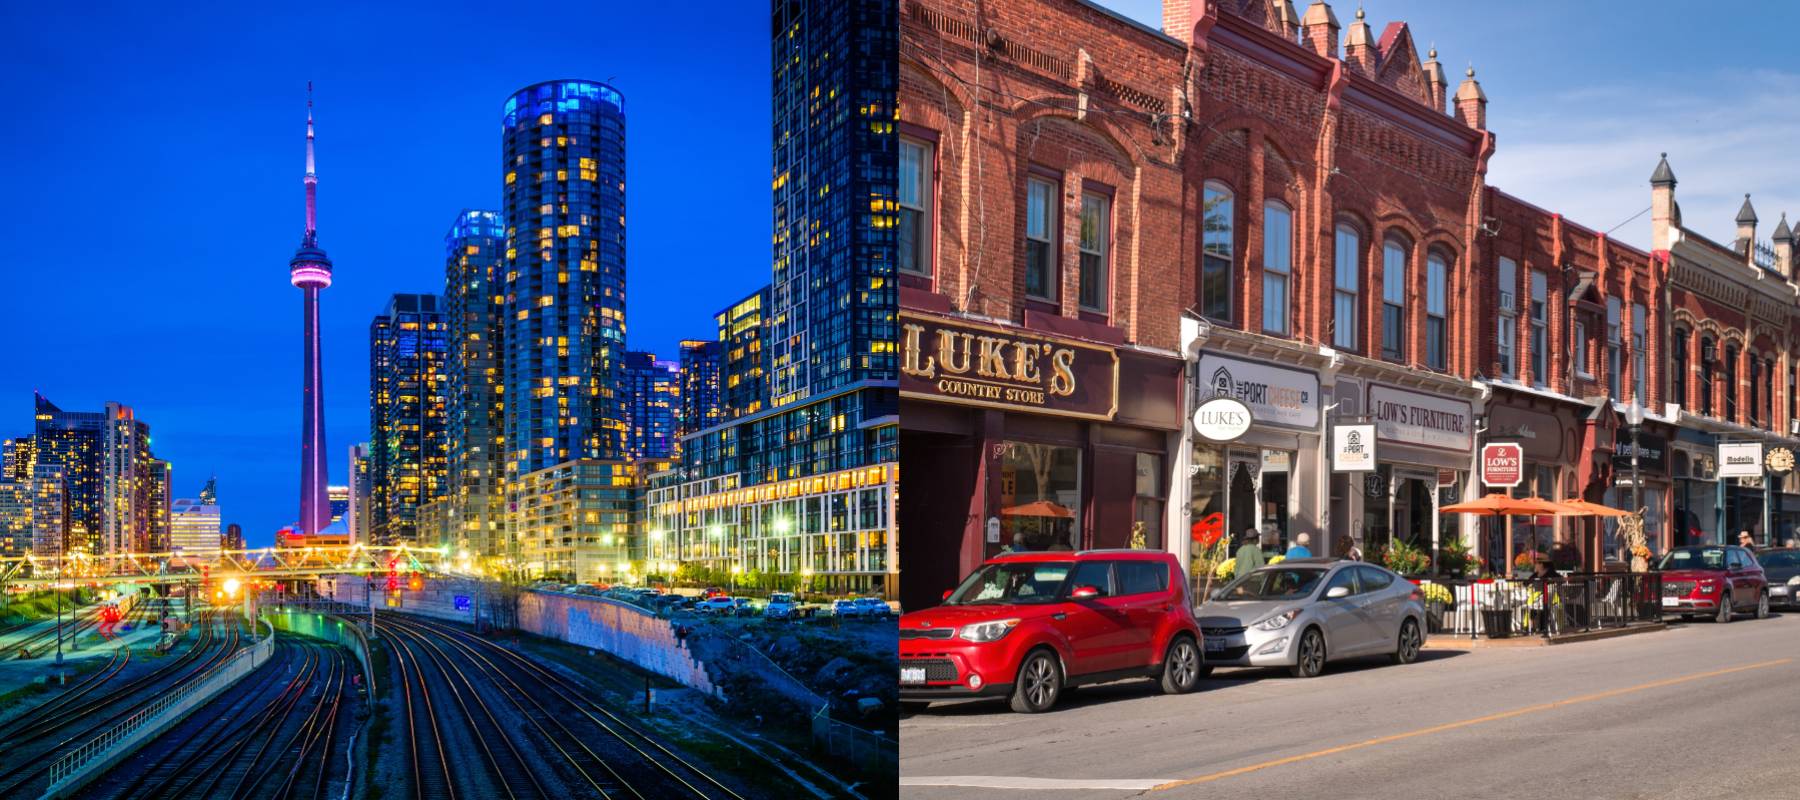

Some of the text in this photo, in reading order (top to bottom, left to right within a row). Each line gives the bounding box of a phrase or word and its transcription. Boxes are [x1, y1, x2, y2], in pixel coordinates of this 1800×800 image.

[902, 324, 1075, 396] LUKE'S
[938, 379, 1045, 404] COUNTRY STORE
[1244, 381, 1268, 405] PORT
[1377, 401, 1407, 424] LOW'S
[1410, 406, 1464, 433] FURNITURE
[1487, 457, 1517, 466] LOW'S
